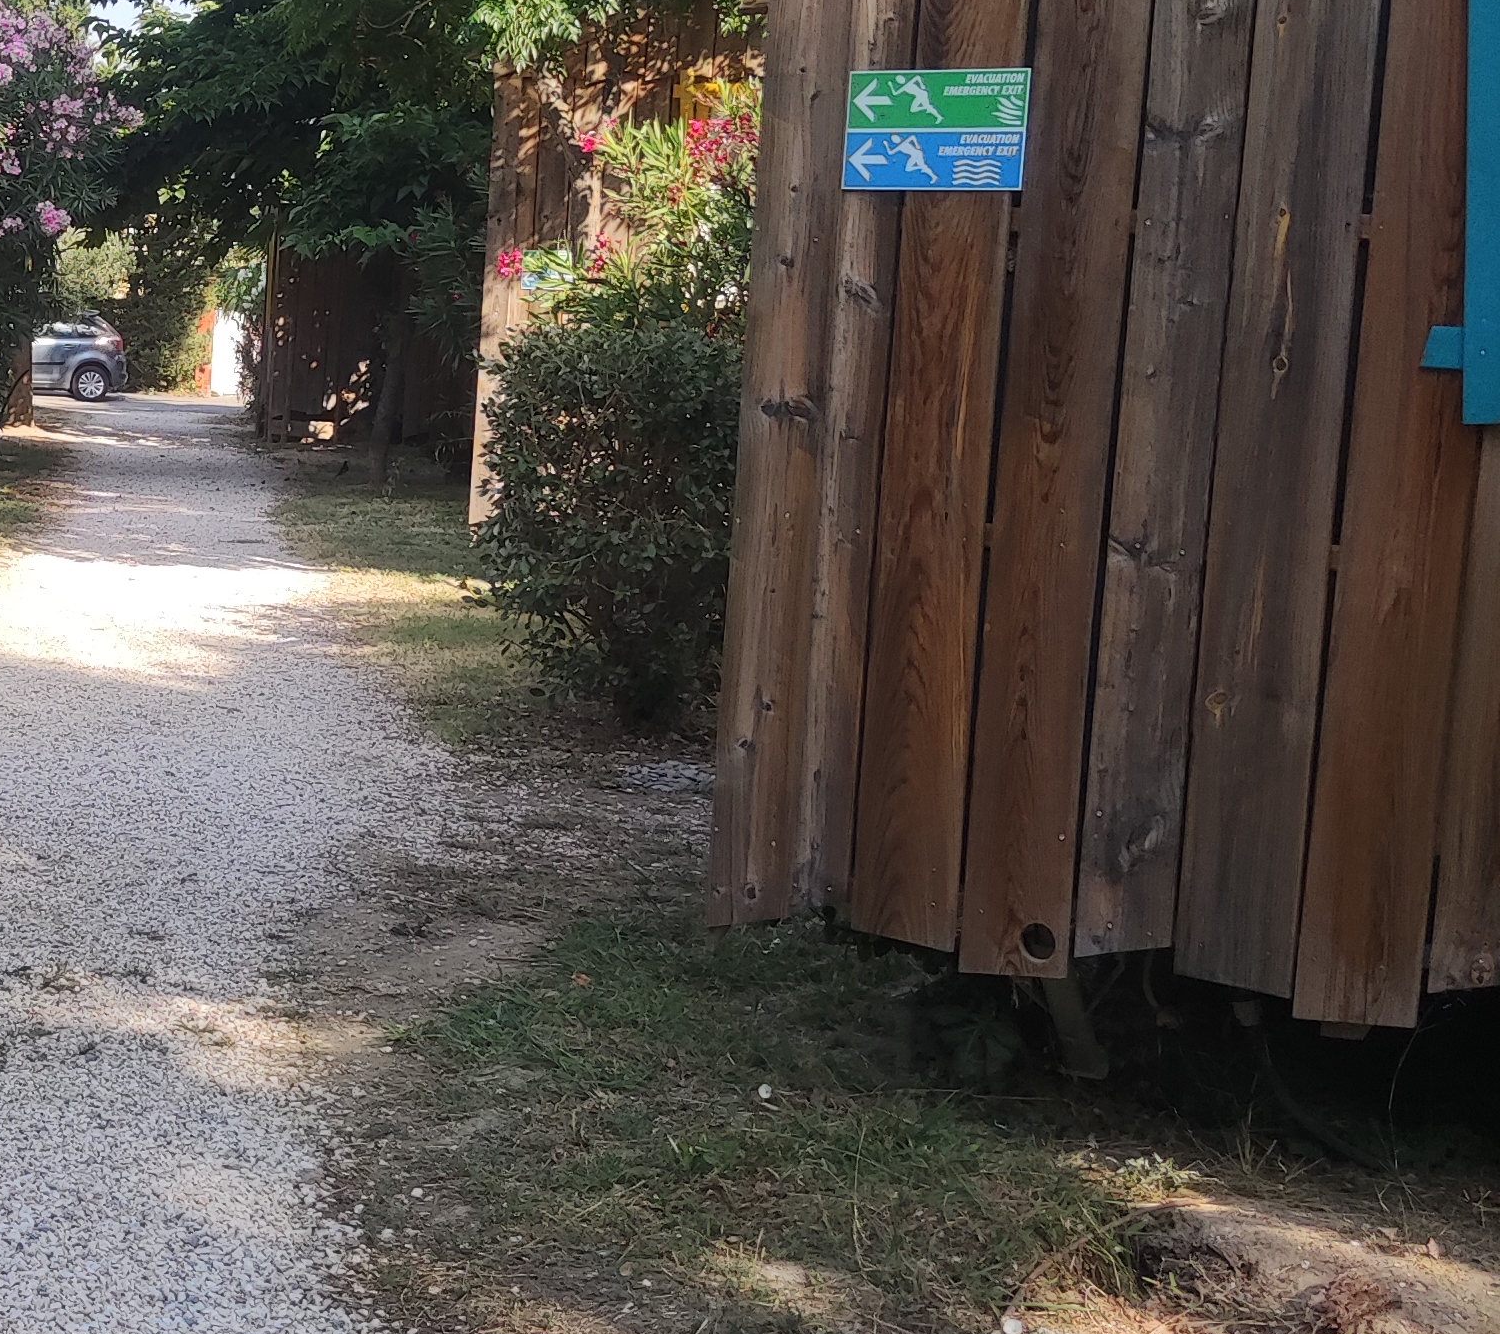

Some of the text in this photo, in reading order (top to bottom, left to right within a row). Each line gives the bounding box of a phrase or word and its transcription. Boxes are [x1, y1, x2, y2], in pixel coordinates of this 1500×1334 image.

[965, 72, 1026, 83] EVACUATION
[943, 84, 1024, 96] EMERGENCY EXIT
[960, 134, 1020, 144] EVACUATION
[938, 145, 1019, 156] EMERGENCY EXIT
